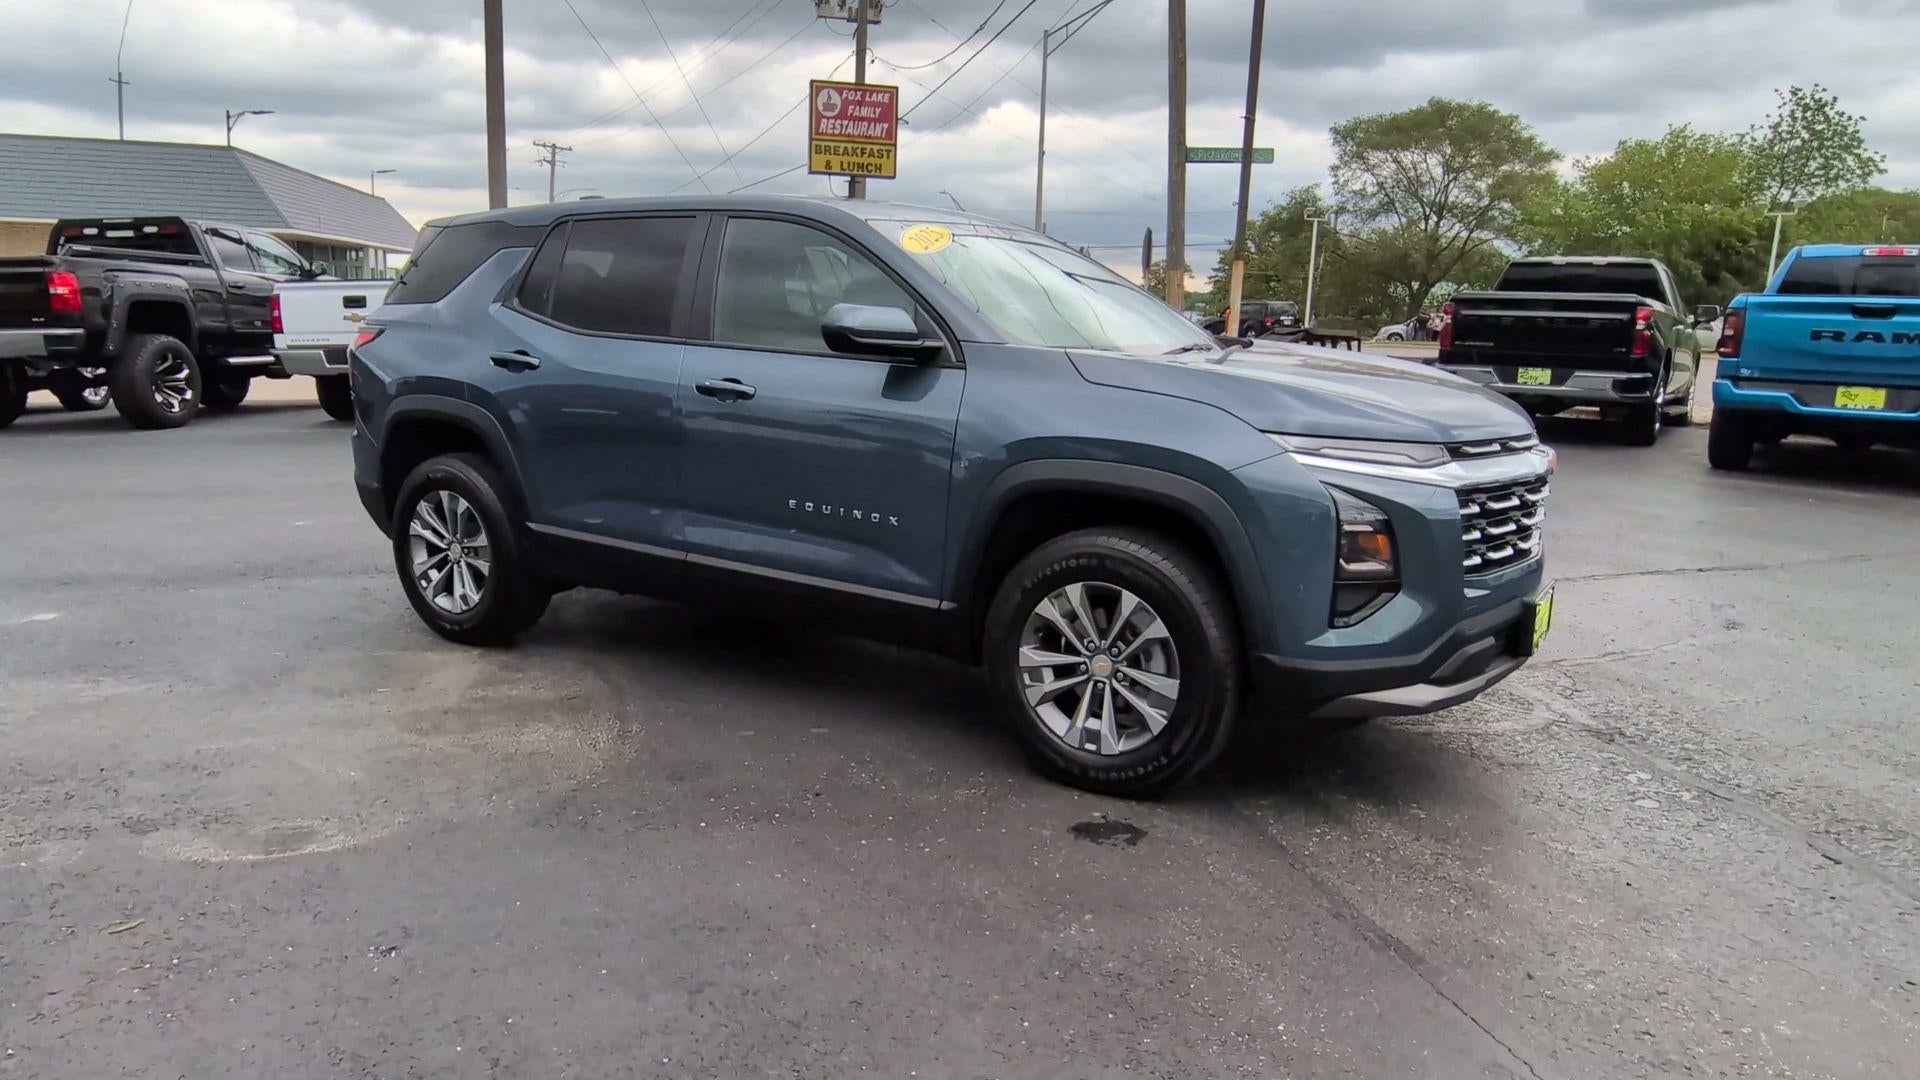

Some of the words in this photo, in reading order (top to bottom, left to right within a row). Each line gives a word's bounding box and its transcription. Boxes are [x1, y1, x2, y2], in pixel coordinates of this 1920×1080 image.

[842, 90, 863, 101] FOX
[866, 91, 891, 103] LAKE
[847, 105, 881, 119] FAMILY
[819, 118, 889, 138] RESTAURANT
[814, 144, 892, 160] BREAKFAST
[824, 160, 833, 171] &
[840, 160, 882, 174] LUNCH
[1810, 328, 1920, 345] RAM
[788, 499, 899, 526] EQUINOX
